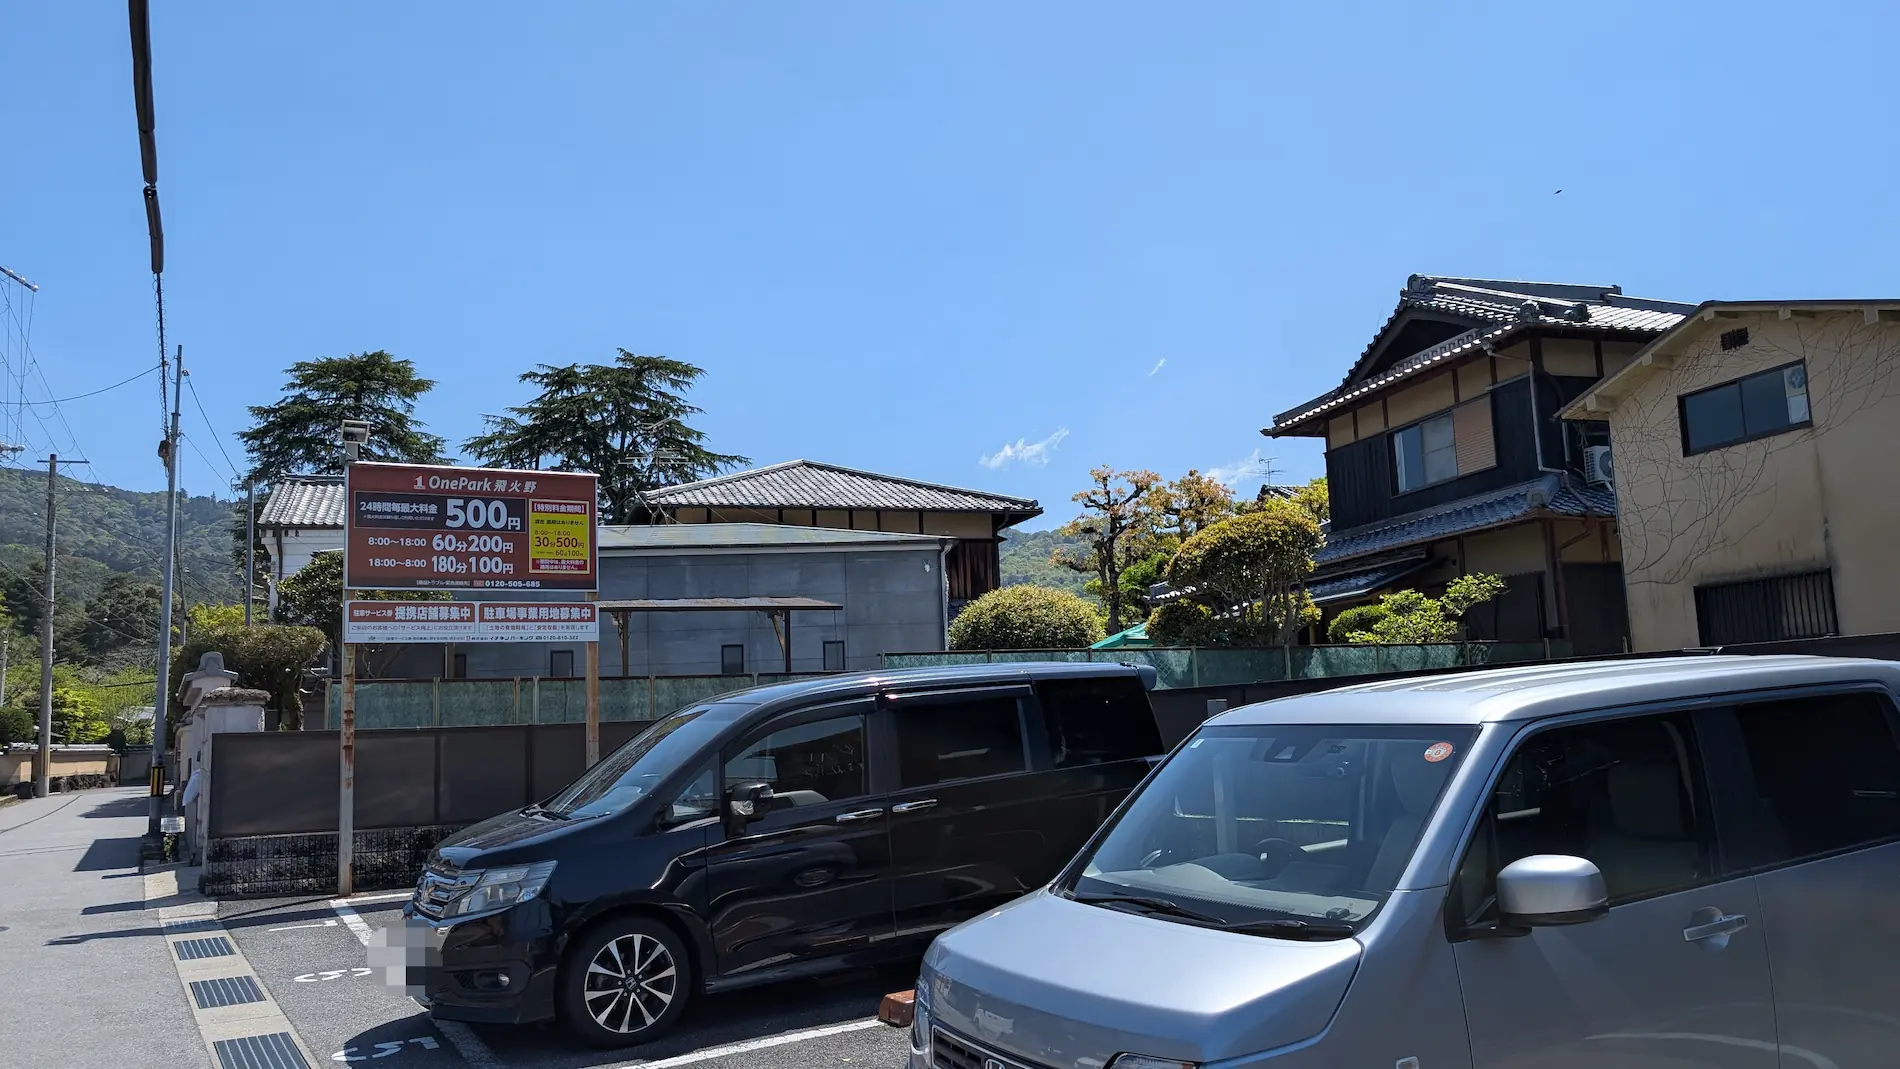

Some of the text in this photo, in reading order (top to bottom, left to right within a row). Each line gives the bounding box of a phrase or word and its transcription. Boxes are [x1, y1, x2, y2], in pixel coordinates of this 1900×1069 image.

[428, 475, 492, 492] OnePark
[494, 479, 537, 494] 飛火野
[359, 501, 438, 514] 24時間毎最大料金
[445, 498, 521, 531] 500円
[367, 534, 514, 554] 8:00～18:00 60分200円
[535, 536, 585, 549] 30分500円
[368, 555, 514, 575] 18:00～8:00 180分100円
[485, 580, 541, 588] 0120-505-685
[394, 605, 471, 621] 提携店舗募集中
[483, 606, 592, 620] 駐車場事業用地募集中
